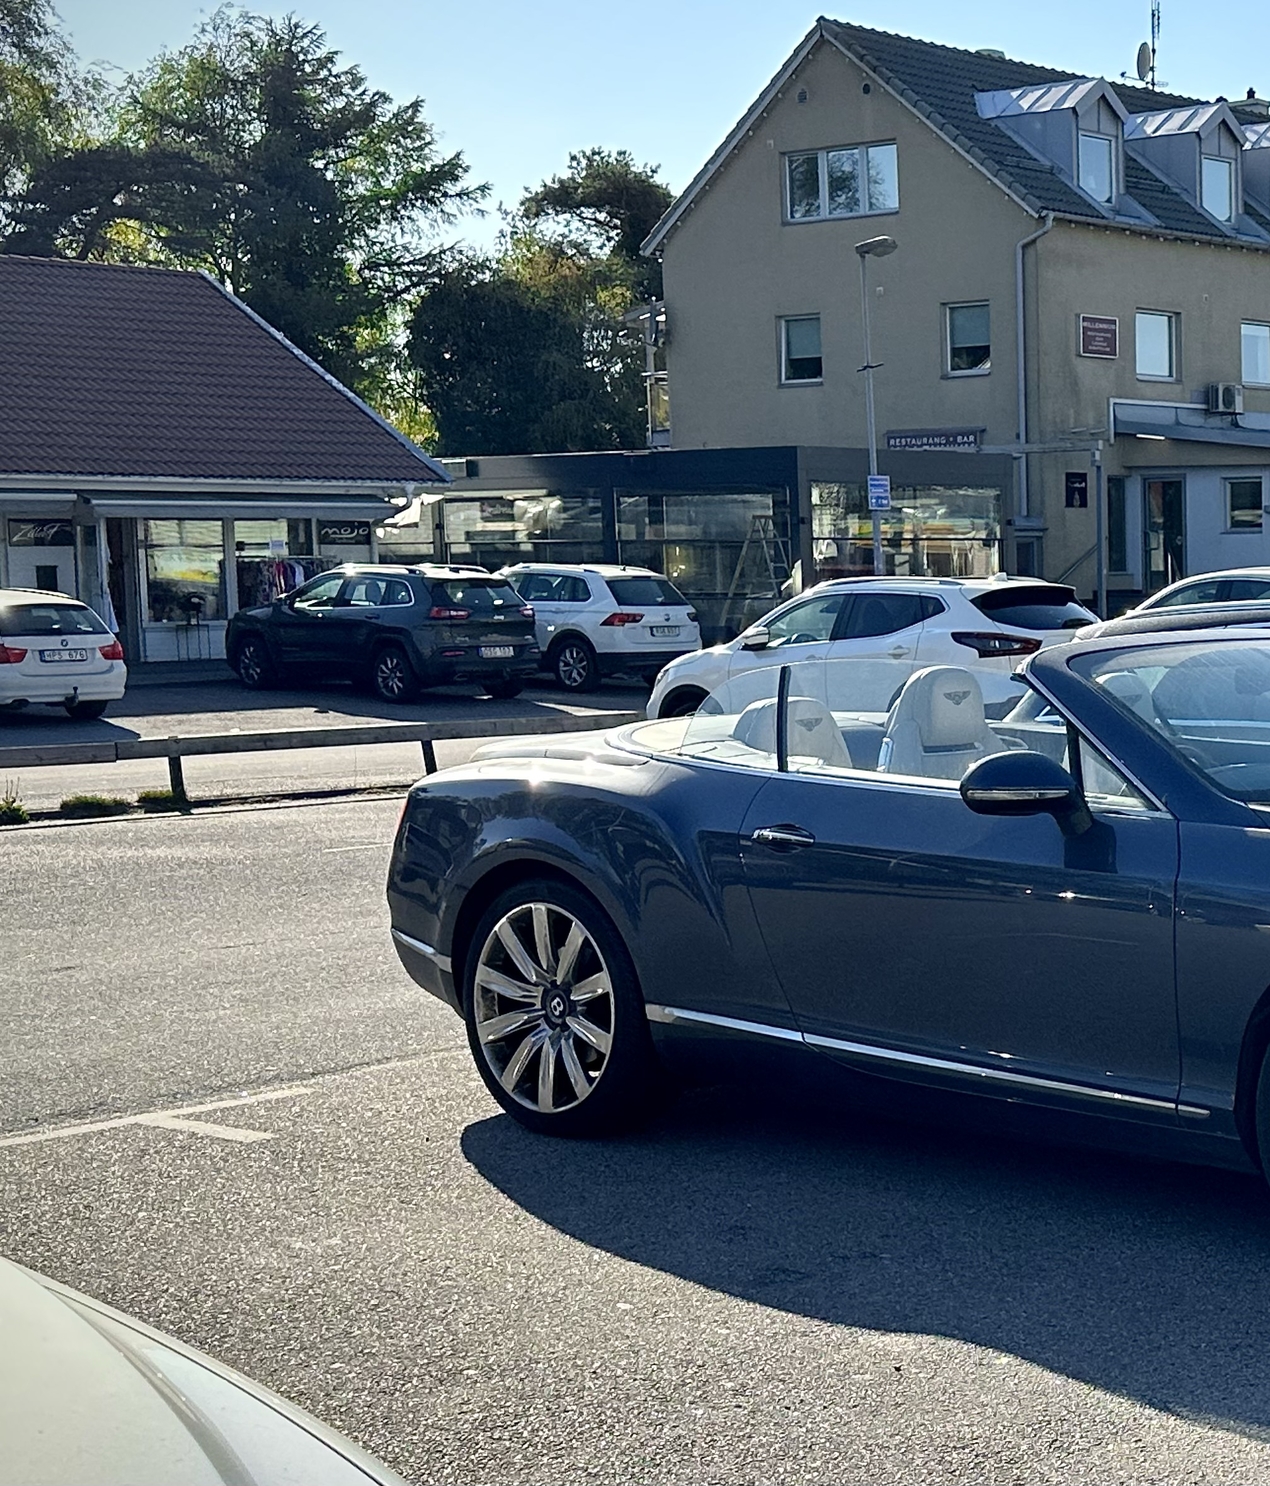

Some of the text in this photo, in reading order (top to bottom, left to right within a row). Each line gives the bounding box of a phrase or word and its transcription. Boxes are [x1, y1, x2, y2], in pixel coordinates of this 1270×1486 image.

[889, 435, 975, 446] RESTAURANG BAR
[321, 521, 369, 538] mojo
